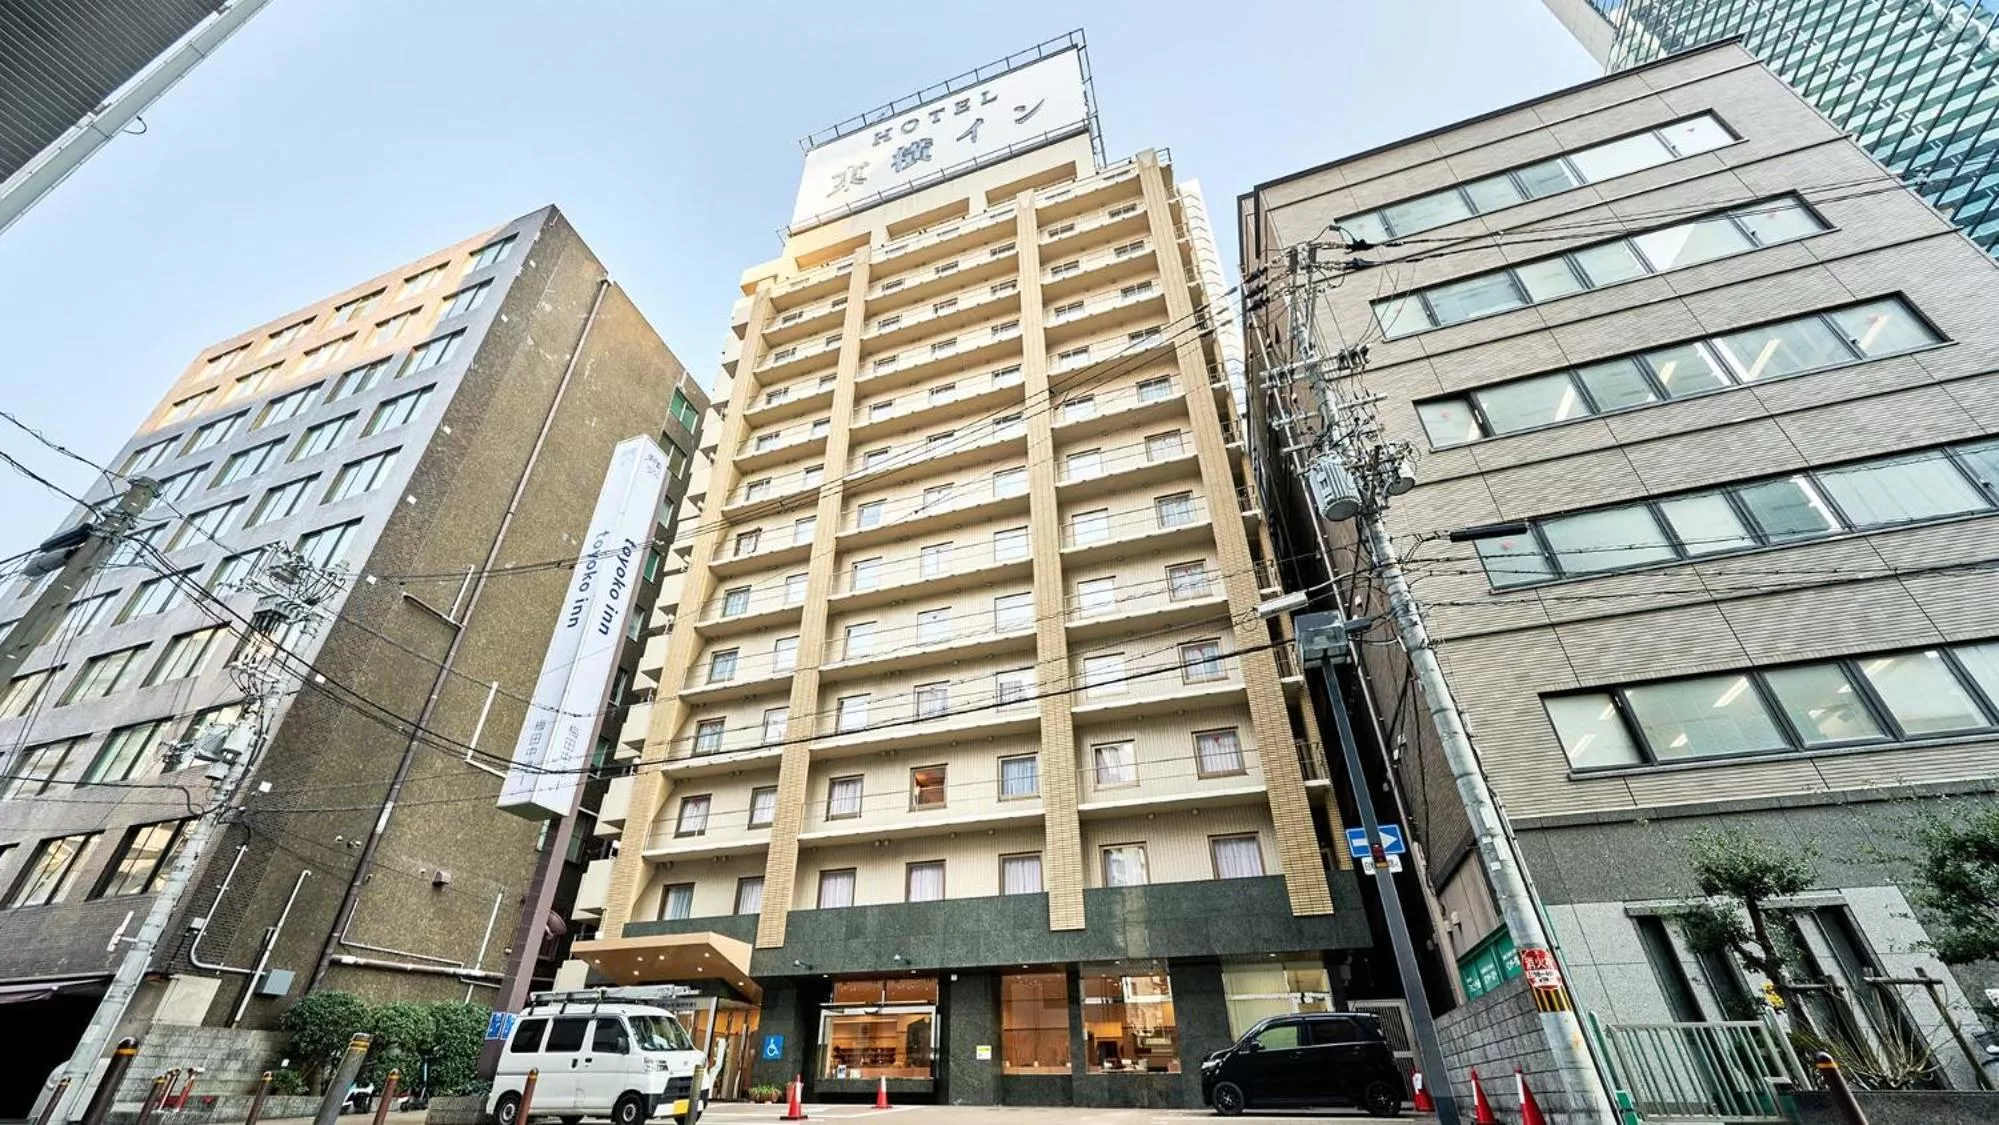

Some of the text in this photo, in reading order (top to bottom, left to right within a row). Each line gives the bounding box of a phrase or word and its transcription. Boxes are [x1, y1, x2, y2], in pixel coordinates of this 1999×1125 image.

[872, 91, 998, 147] HOTEL
[567, 530, 610, 628] toyoko inn
[598, 538, 637, 635] toyoko inn
